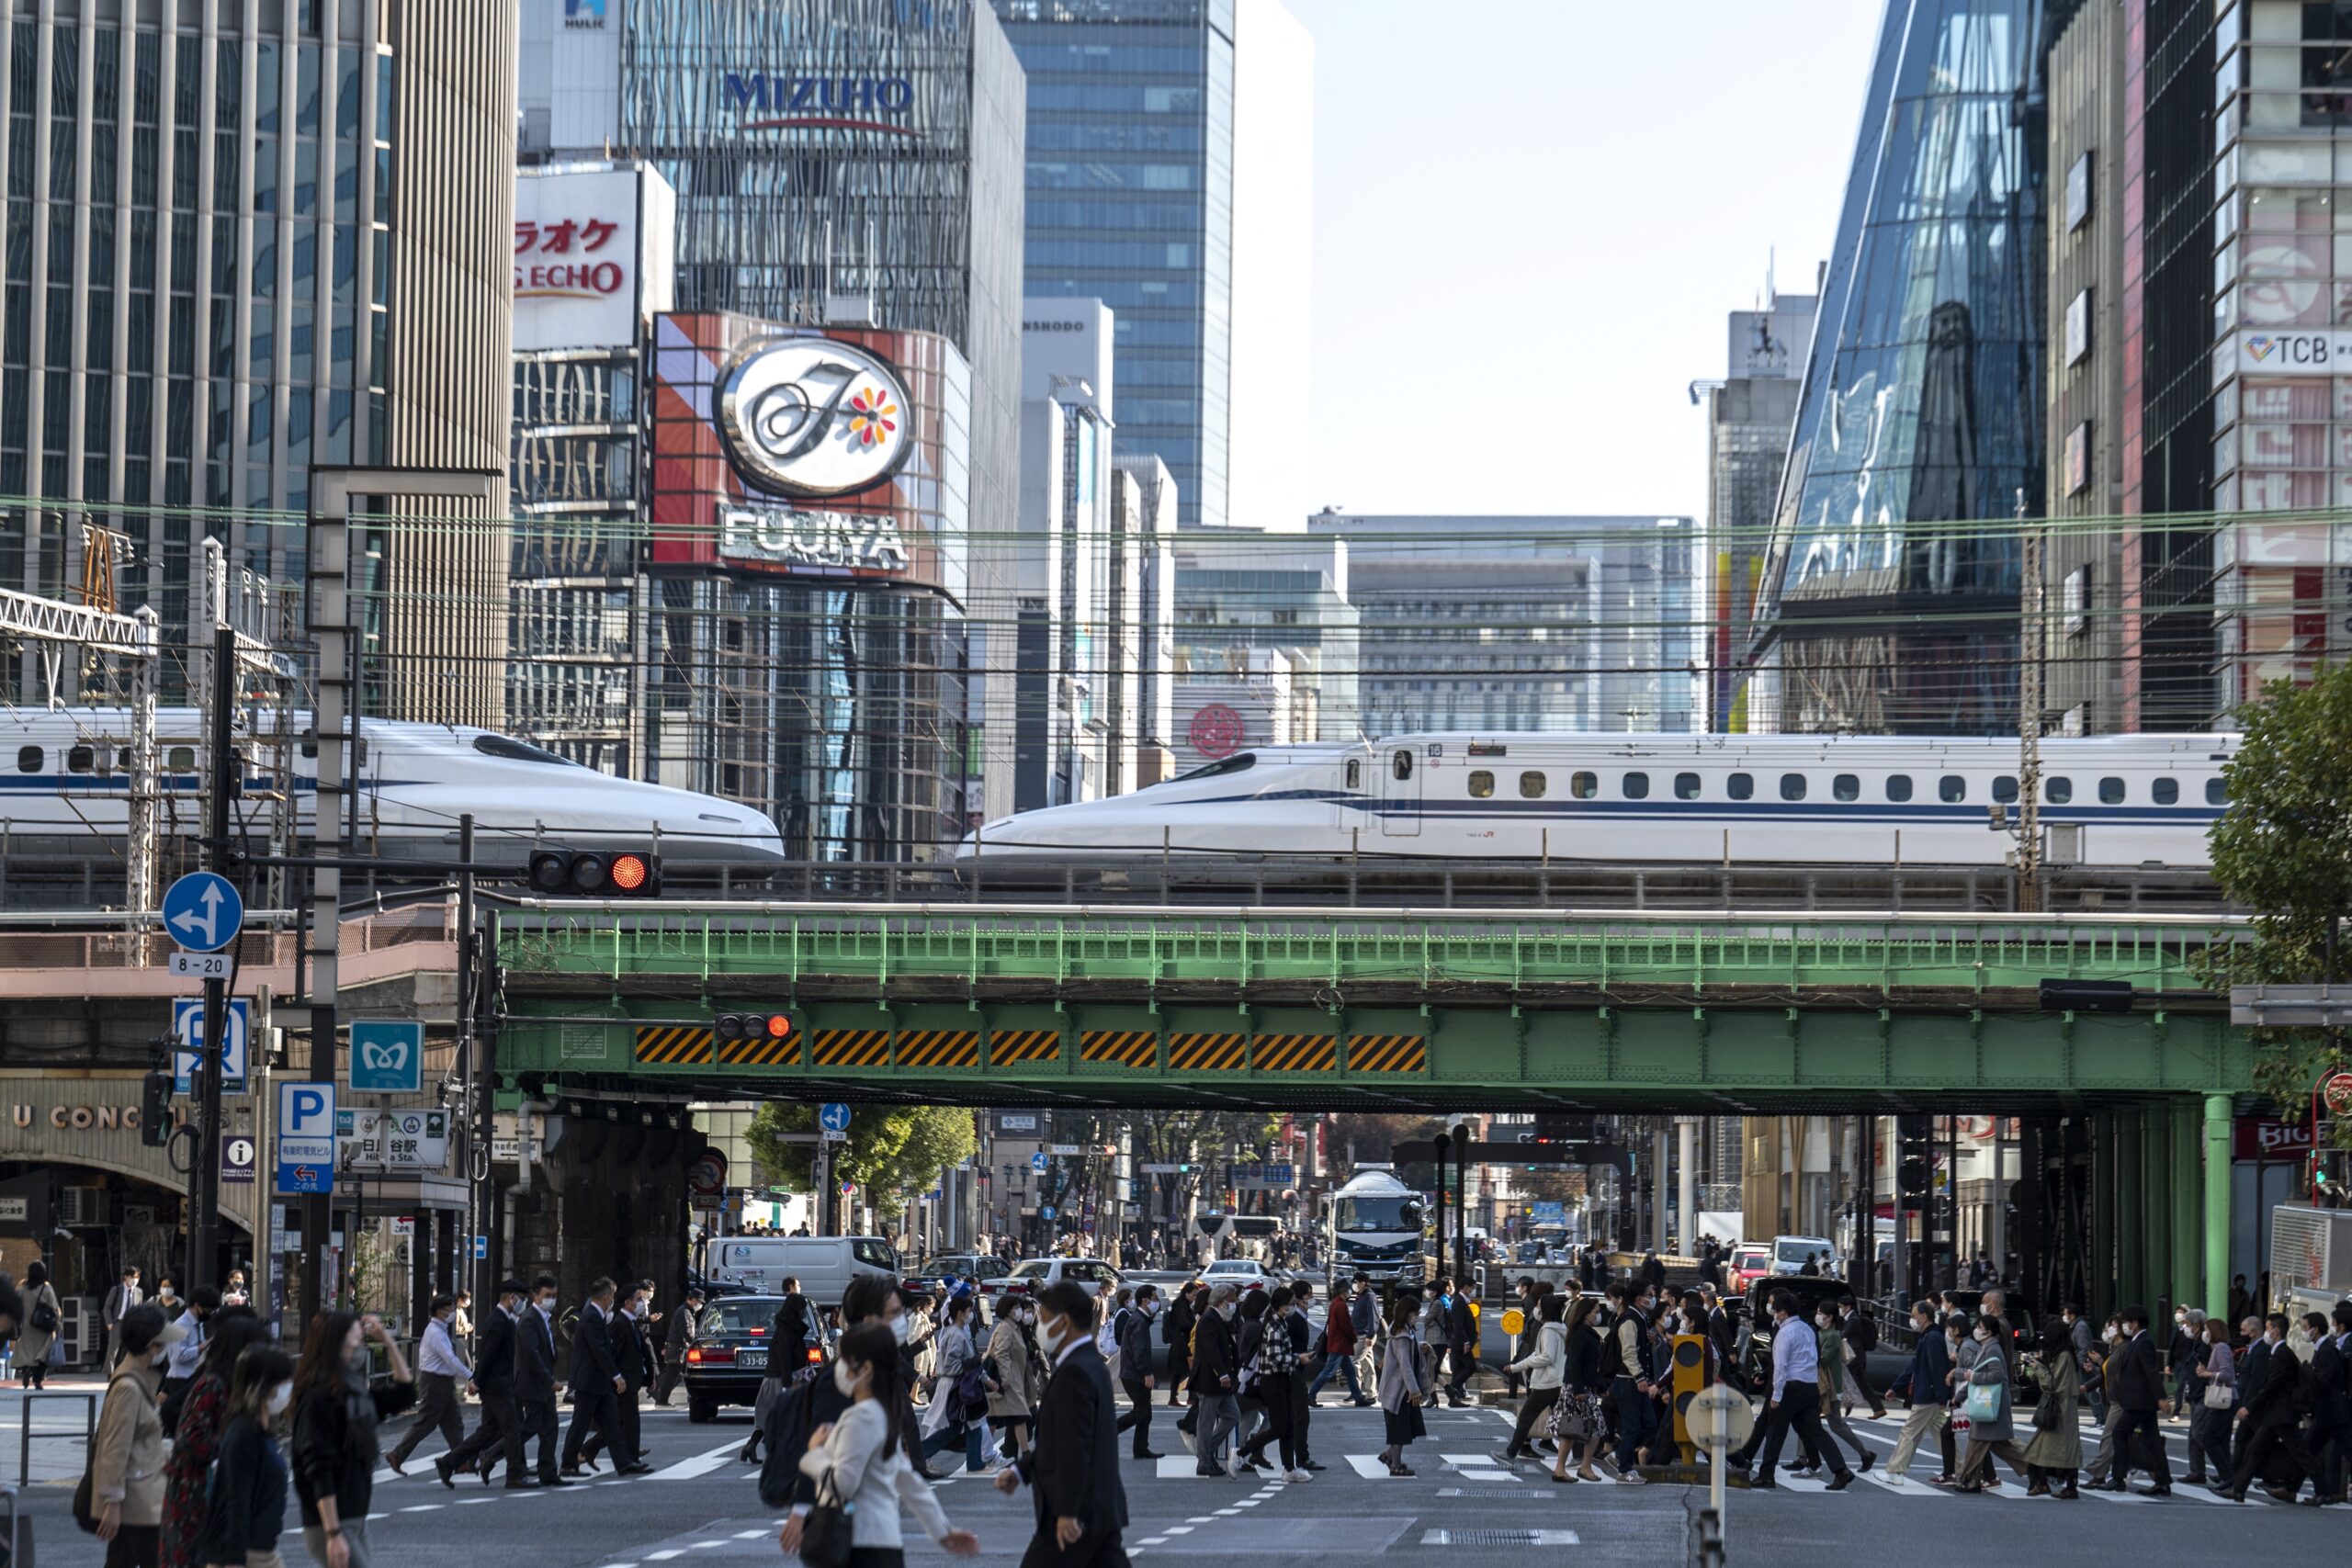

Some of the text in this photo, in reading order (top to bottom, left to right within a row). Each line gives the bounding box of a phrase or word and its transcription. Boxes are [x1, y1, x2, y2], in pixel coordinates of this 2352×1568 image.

[565, 19, 605, 29] HULIC
[724, 73, 914, 111] MIZUHO
[530, 261, 623, 294] ECHO
[2276, 336, 2328, 364] TCB
[725, 511, 910, 562] FUJIYA
[292, 1090, 324, 1131] P
[282, 1145, 331, 1156] 有楽町電気ビル
[398, 1154, 416, 1162] Sta.
[293, 1182, 319, 1190] この先
